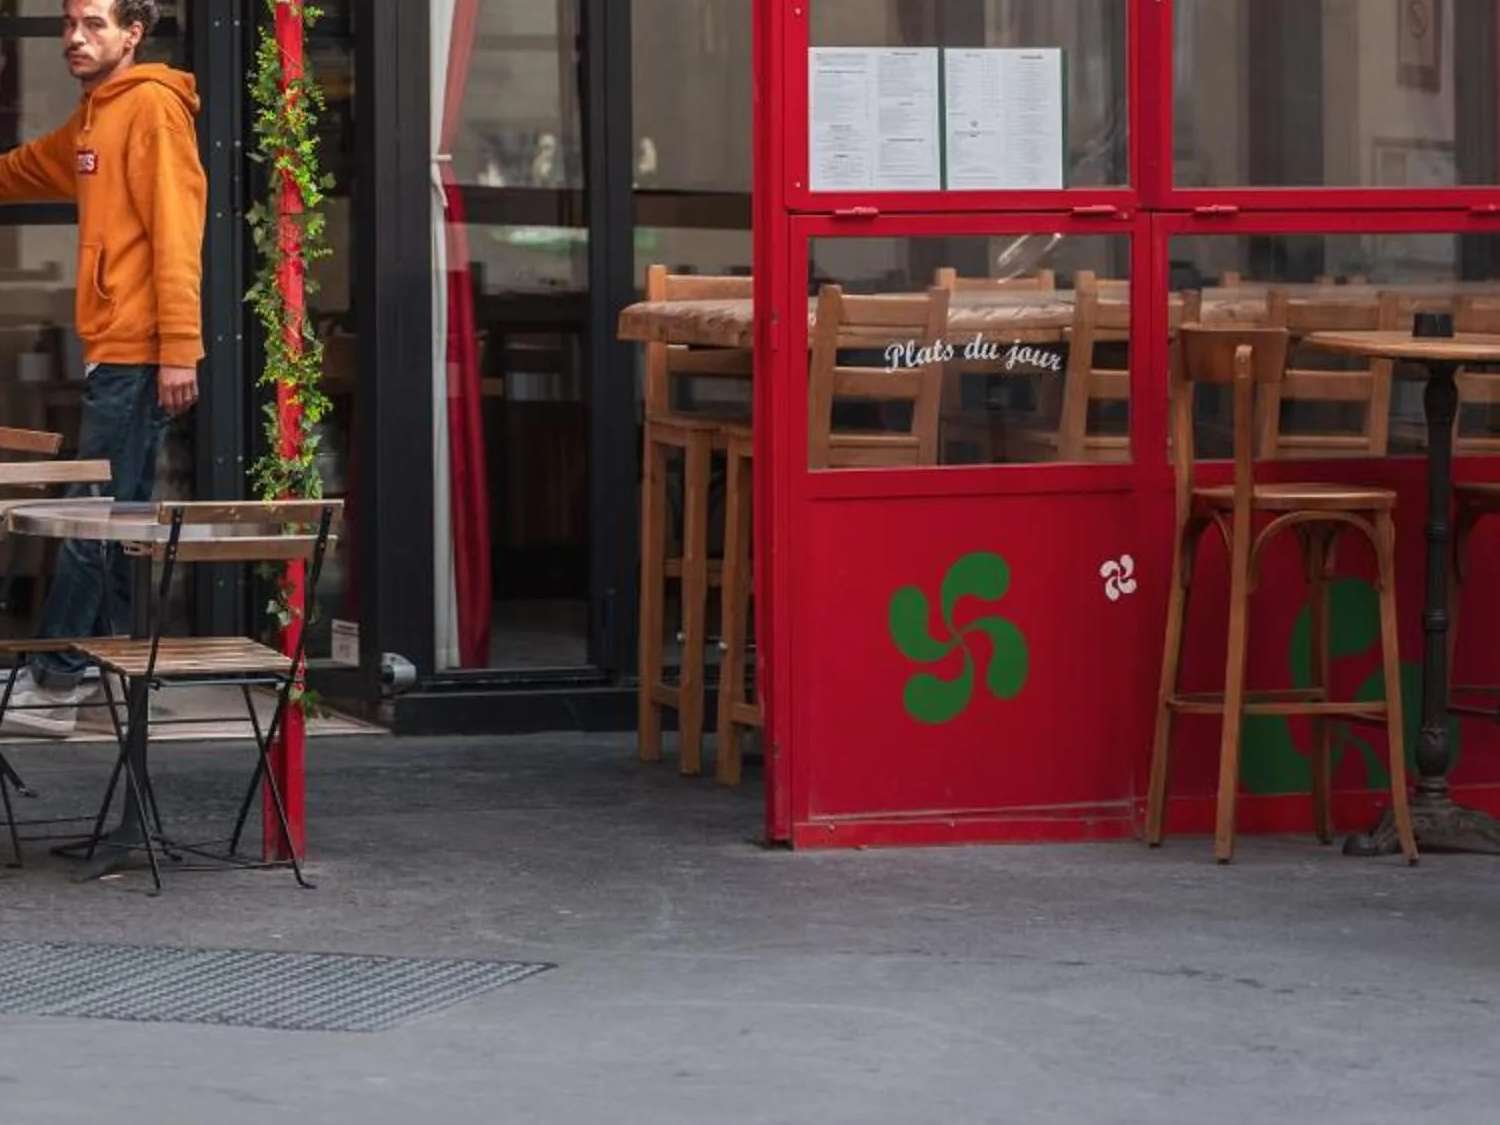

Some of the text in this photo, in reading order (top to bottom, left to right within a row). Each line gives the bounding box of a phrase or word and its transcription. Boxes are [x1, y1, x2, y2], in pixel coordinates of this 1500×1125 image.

[883, 332, 1064, 374] Plats du jour
